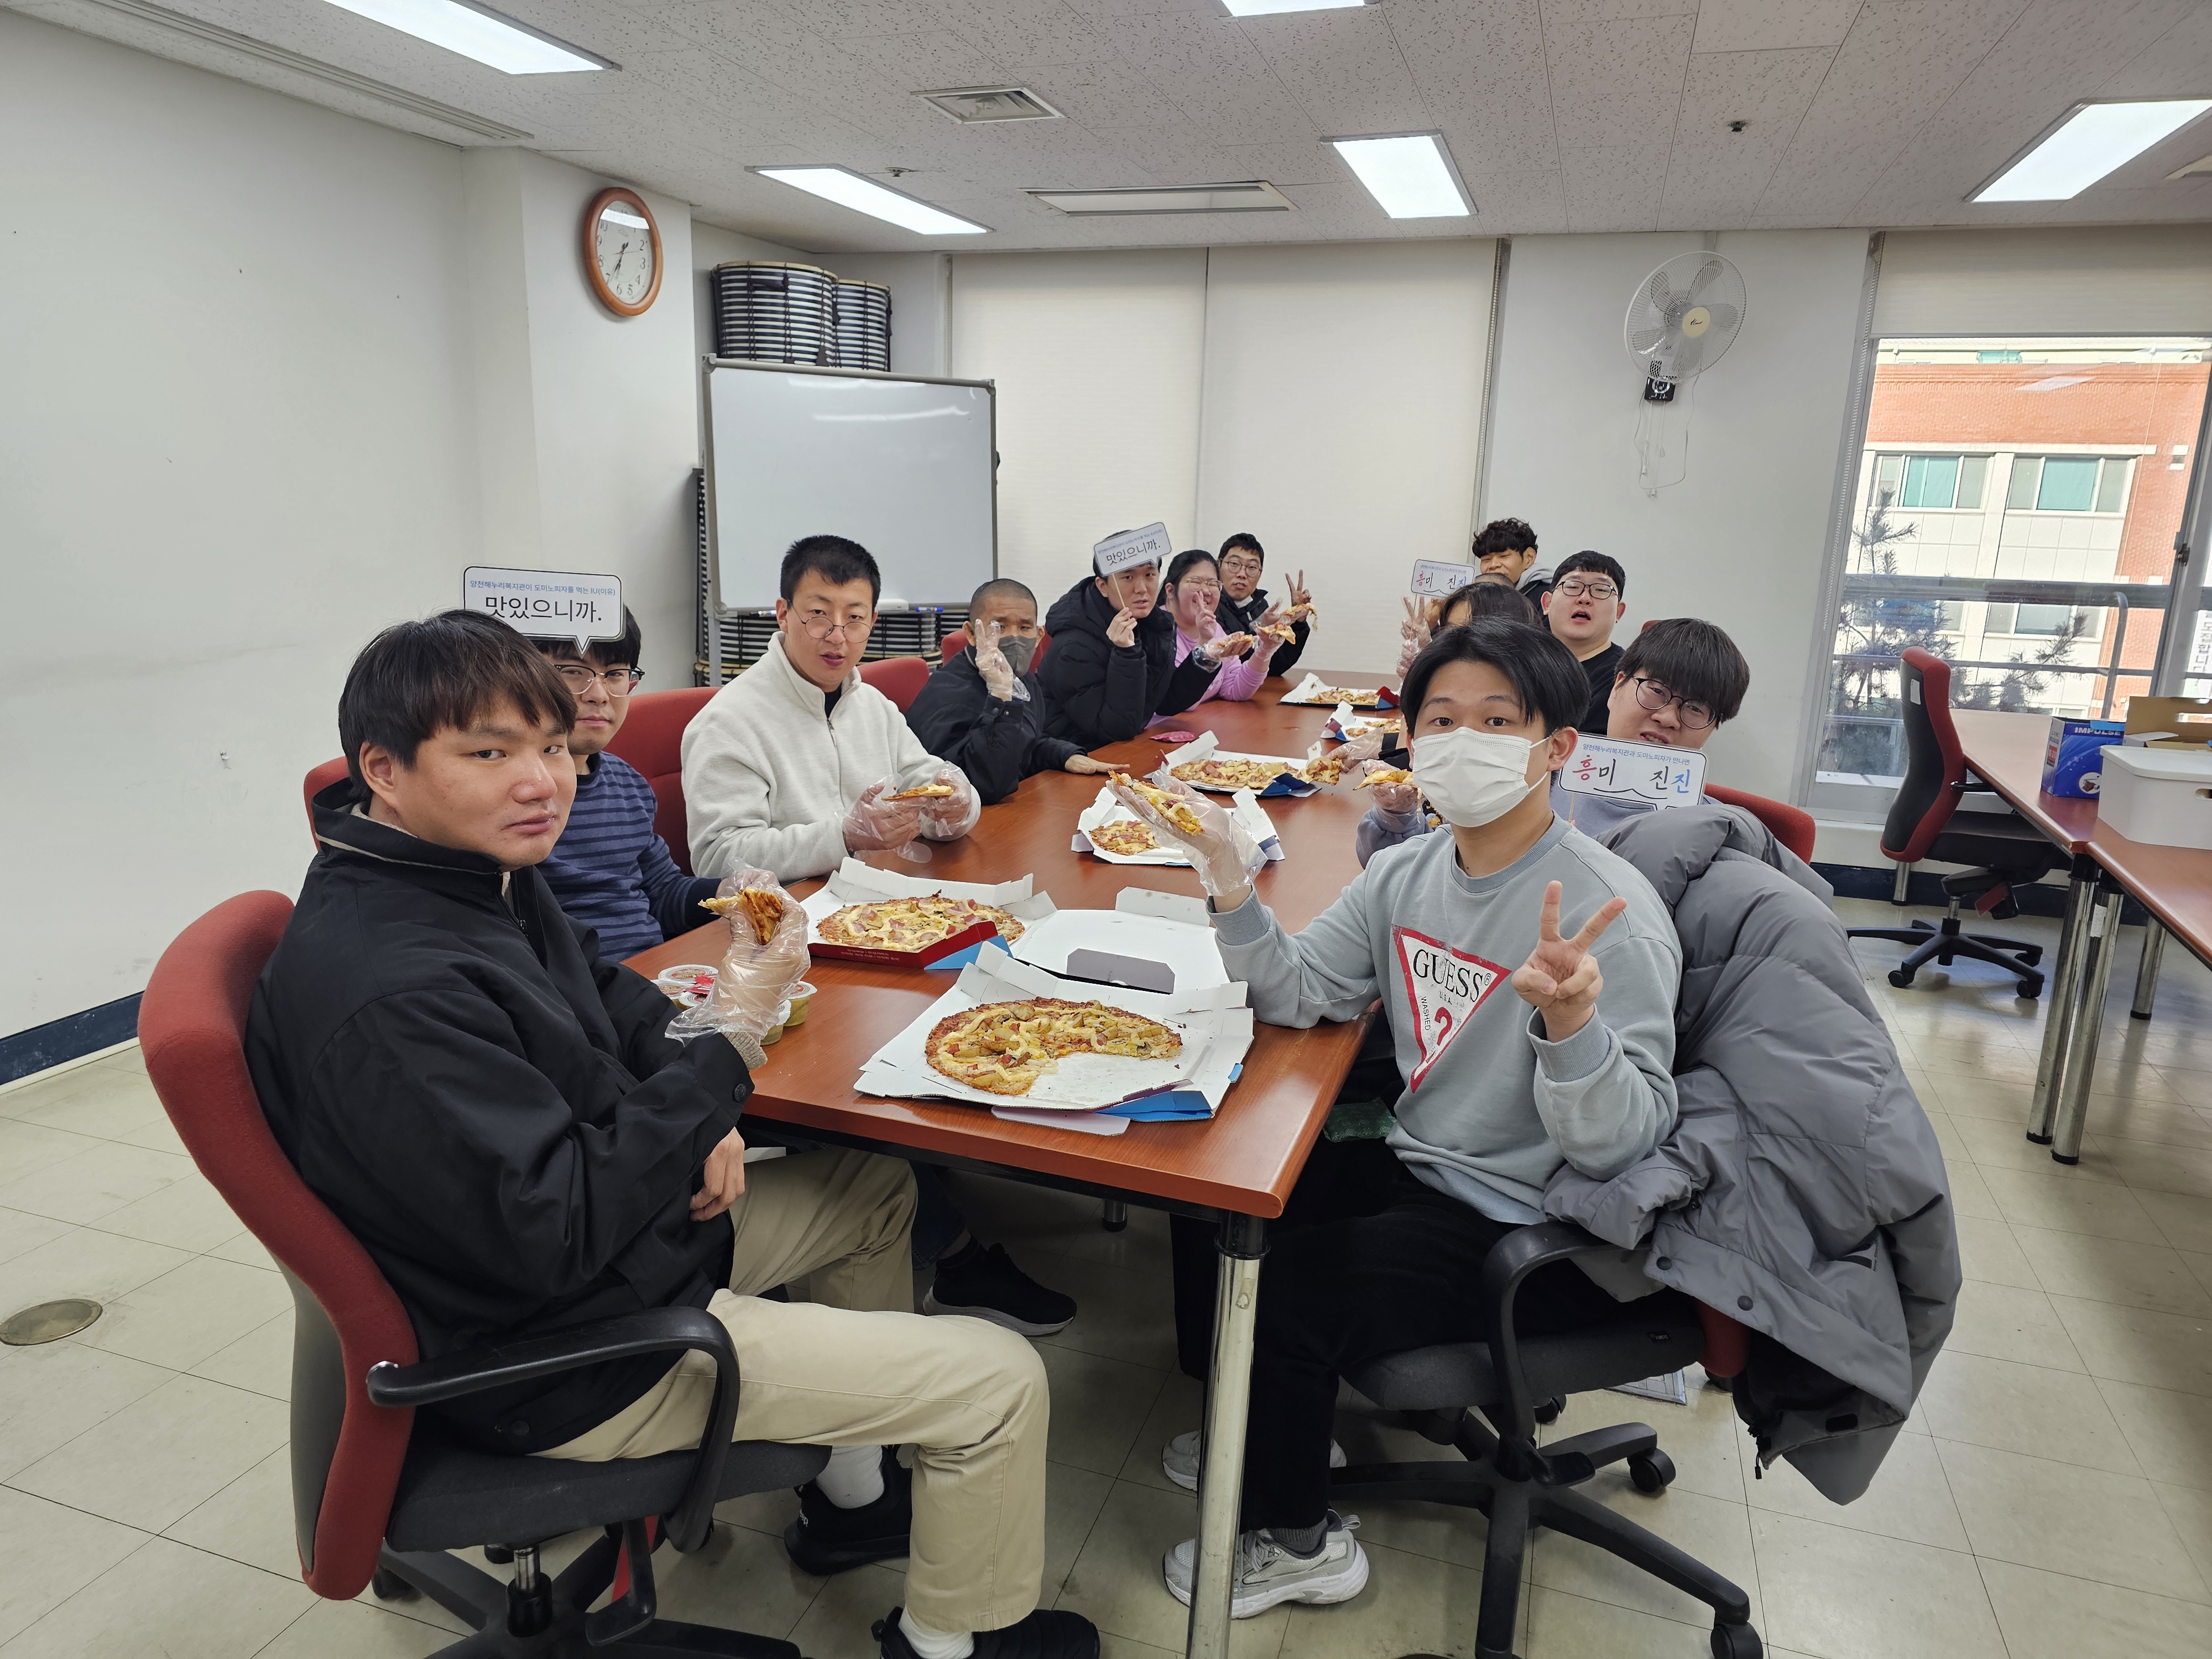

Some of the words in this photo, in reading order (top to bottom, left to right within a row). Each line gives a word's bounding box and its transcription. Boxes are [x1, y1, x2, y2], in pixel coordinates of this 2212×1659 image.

[640, 239, 645, 251] 2
[598, 255, 604, 268] 8
[640, 257, 646, 270] 3
[635, 275, 640, 285] 4
[617, 283, 622, 295] 6
[627, 284, 633, 296] 5
[1107, 539, 1161, 566] 맛있으니까.
[1416, 571, 1433, 588] 흥미
[470, 580, 532, 591] 양천해누리복지관이
[534, 585, 573, 593] 도미노피자를
[591, 588, 615, 596] IU(이유)
[486, 596, 602, 623] 맛있으니까.
[2074, 727, 2121, 736] IMPULSE
[1583, 744, 1635, 757] 양천해누리복지관과
[1636, 752, 1671, 763] 도미노피자가
[1673, 757, 1691, 765] 만나면
[1572, 754, 1616, 786] 흥미
[1649, 766, 1690, 794] 진진
[1413, 949, 1483, 1003] GUESS
[1421, 996, 1431, 1031] WASHED
